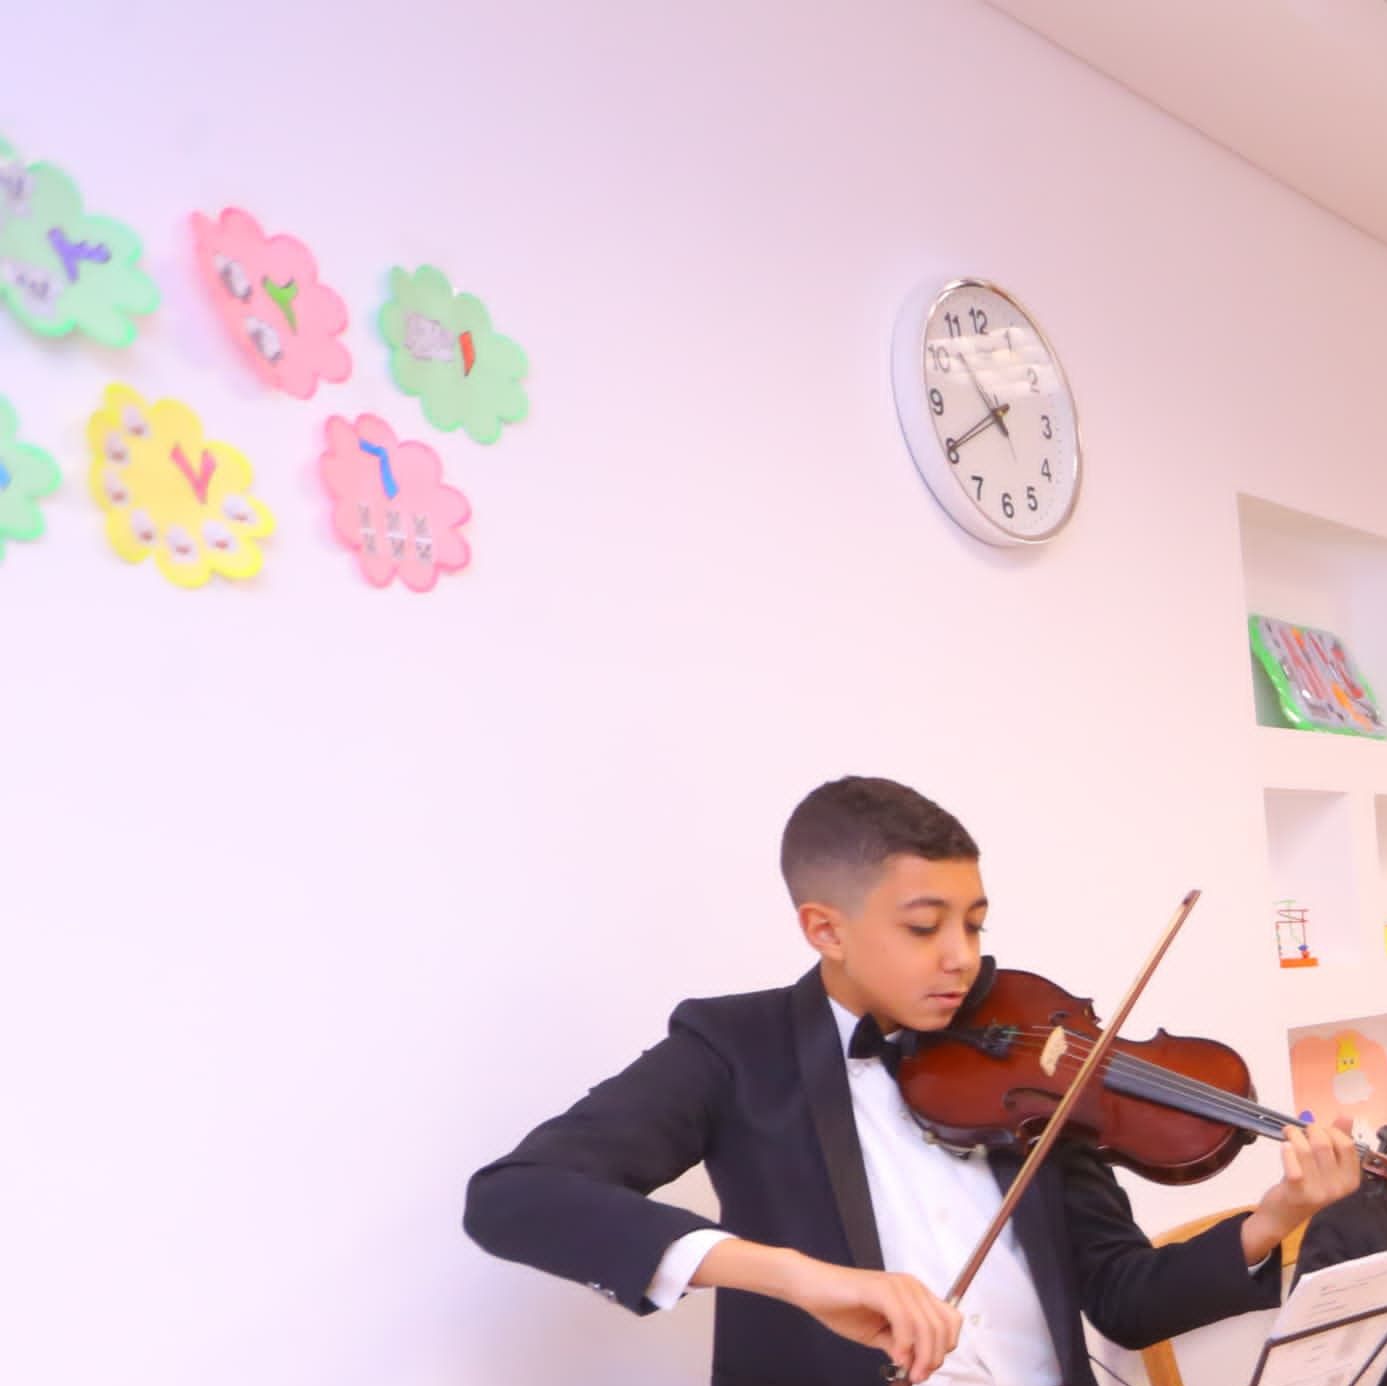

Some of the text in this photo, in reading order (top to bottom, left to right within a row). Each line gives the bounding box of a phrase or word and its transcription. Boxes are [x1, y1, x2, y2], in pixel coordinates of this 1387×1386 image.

[944, 312, 962, 338] 11
[969, 305, 989, 336] 12
[927, 343, 951, 372] 10
[1026, 367, 1041, 394] 2
[929, 388, 945, 416] 9
[1041, 415, 1053, 440] 3
[945, 438, 960, 464] 8
[1041, 458, 1053, 482] 4
[971, 475, 984, 501] 7
[1026, 486, 1038, 511] 5
[1001, 492, 1015, 518] 6
